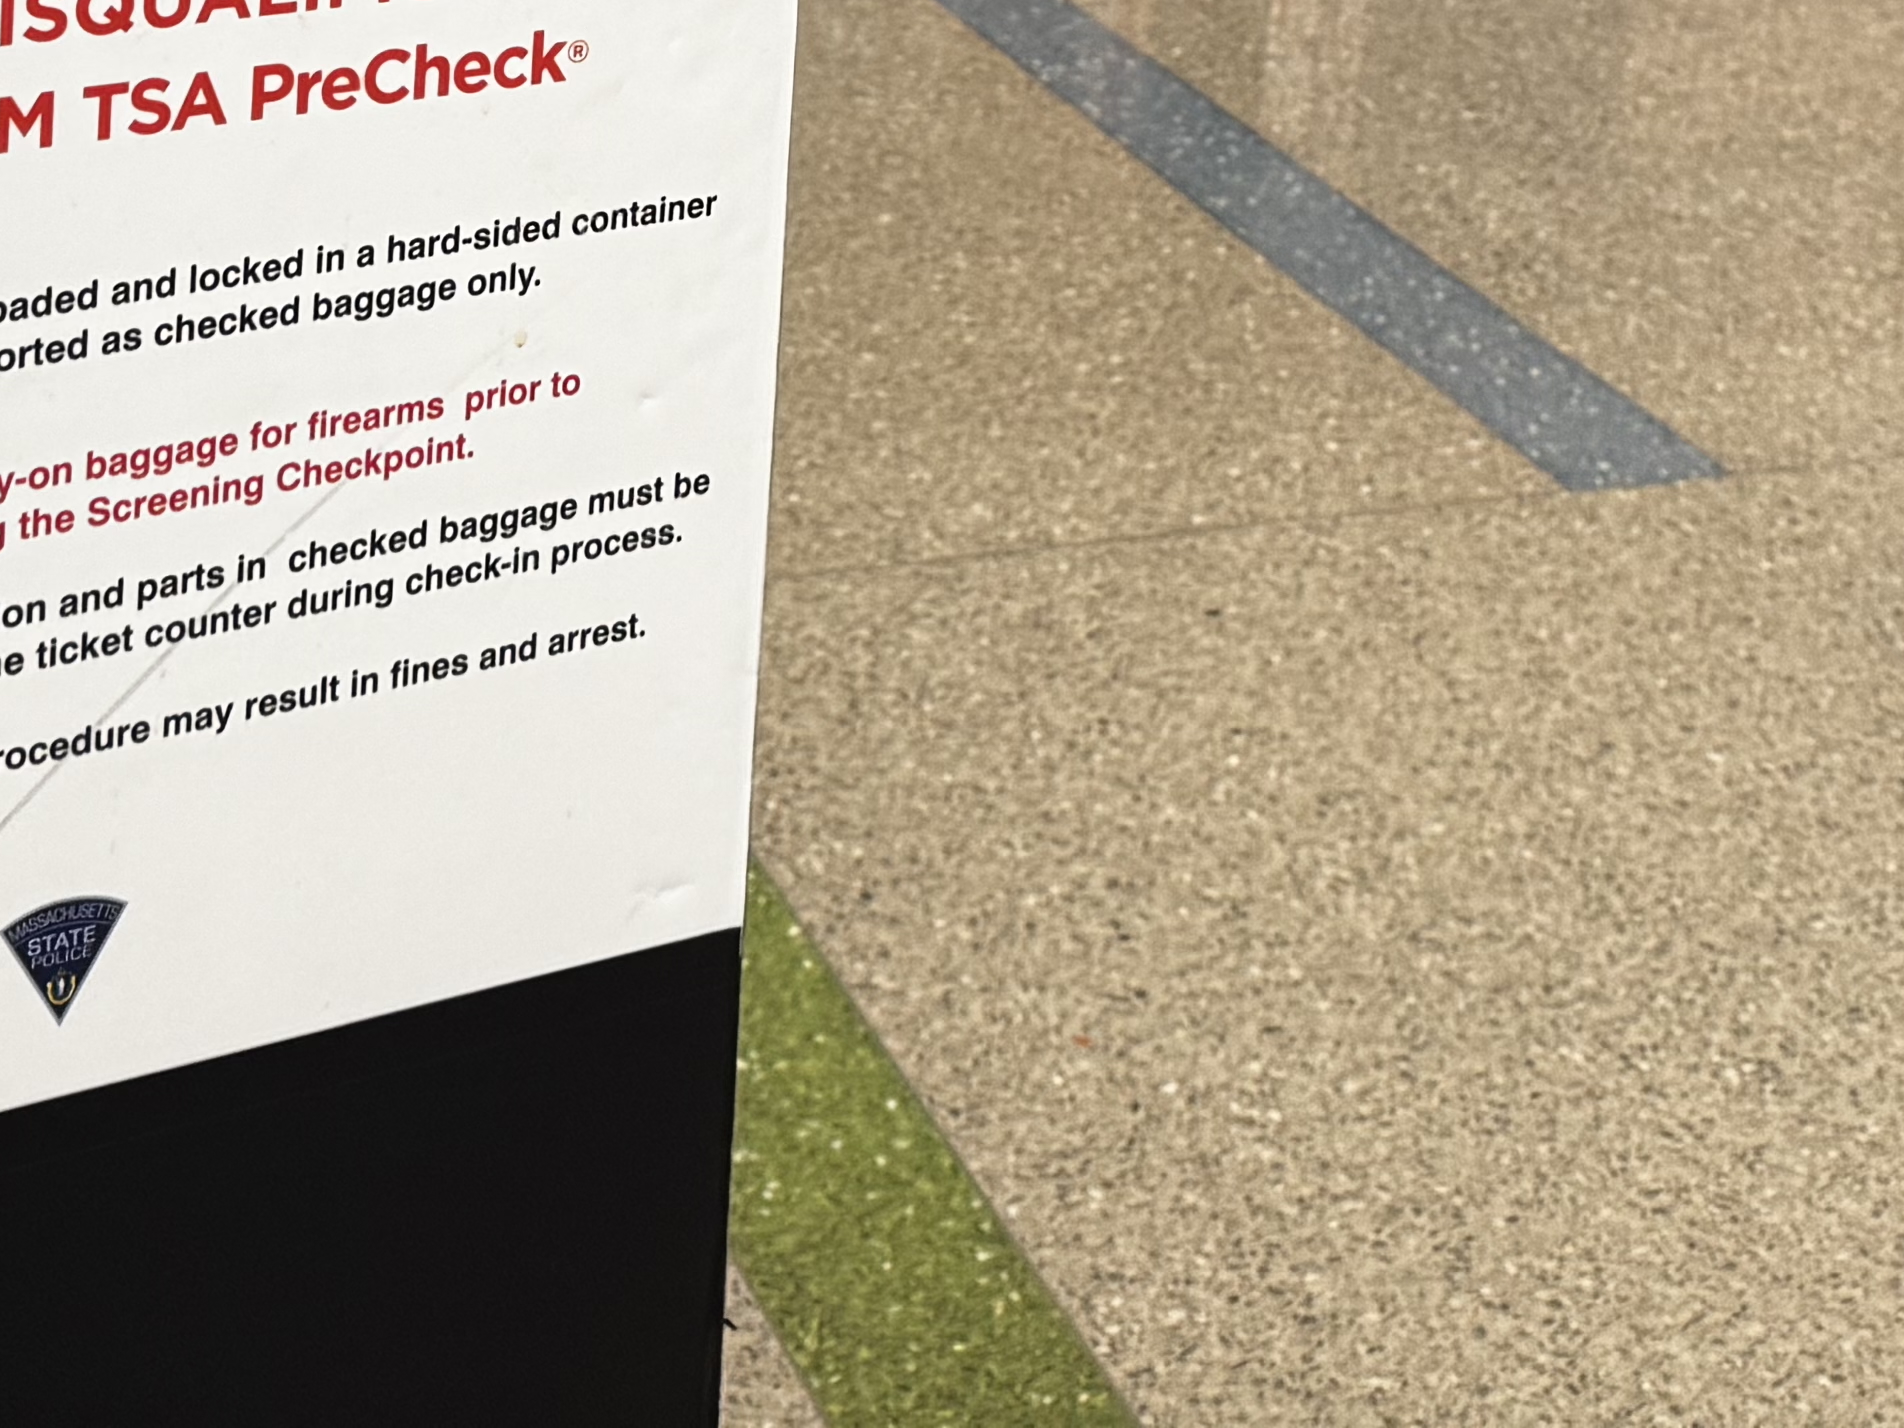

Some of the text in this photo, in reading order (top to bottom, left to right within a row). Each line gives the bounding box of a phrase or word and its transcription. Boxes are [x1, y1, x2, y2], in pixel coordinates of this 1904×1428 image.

[83, 72, 226, 140] TSA
[112, 268, 176, 305] and
[190, 249, 303, 293] locked
[317, 246, 344, 273] in
[357, 245, 374, 267] a
[388, 211, 560, 263] hard-sided
[572, 196, 717, 235] container
[102, 328, 141, 354] as
[155, 296, 299, 345] checked
[313, 279, 456, 321] baggage
[468, 263, 540, 296] only.
[87, 434, 238, 480] baggage
[250, 422, 297, 450] for
[308, 398, 443, 440] firearms
[465, 380, 541, 420] prior
[551, 372, 580, 397] to
[19, 509, 74, 539] the
[88, 475, 263, 526] Screening
[277, 434, 473, 491] Checkpoint.
[37, 625, 133, 668] ticket
[146, 602, 276, 647] counter
[288, 579, 393, 618] during
[406, 547, 539, 594] check-in
[552, 525, 681, 574] process.
[60, 578, 123, 617] and
[138, 564, 224, 610] parts
[238, 555, 265, 583] in
[289, 520, 427, 572] checked
[440, 499, 577, 543] baggage
[589, 477, 663, 515] must
[674, 473, 709, 498] be
[164, 703, 233, 737] may
[246, 676, 339, 720] result
[352, 670, 378, 697] in
[391, 654, 468, 688] fines
[480, 633, 537, 670] and
[549, 614, 645, 655] arrest.
[7, 903, 119, 943] MASSACHUSETTS
[27, 924, 97, 957] STATE
[31, 944, 93, 970] POLICE
